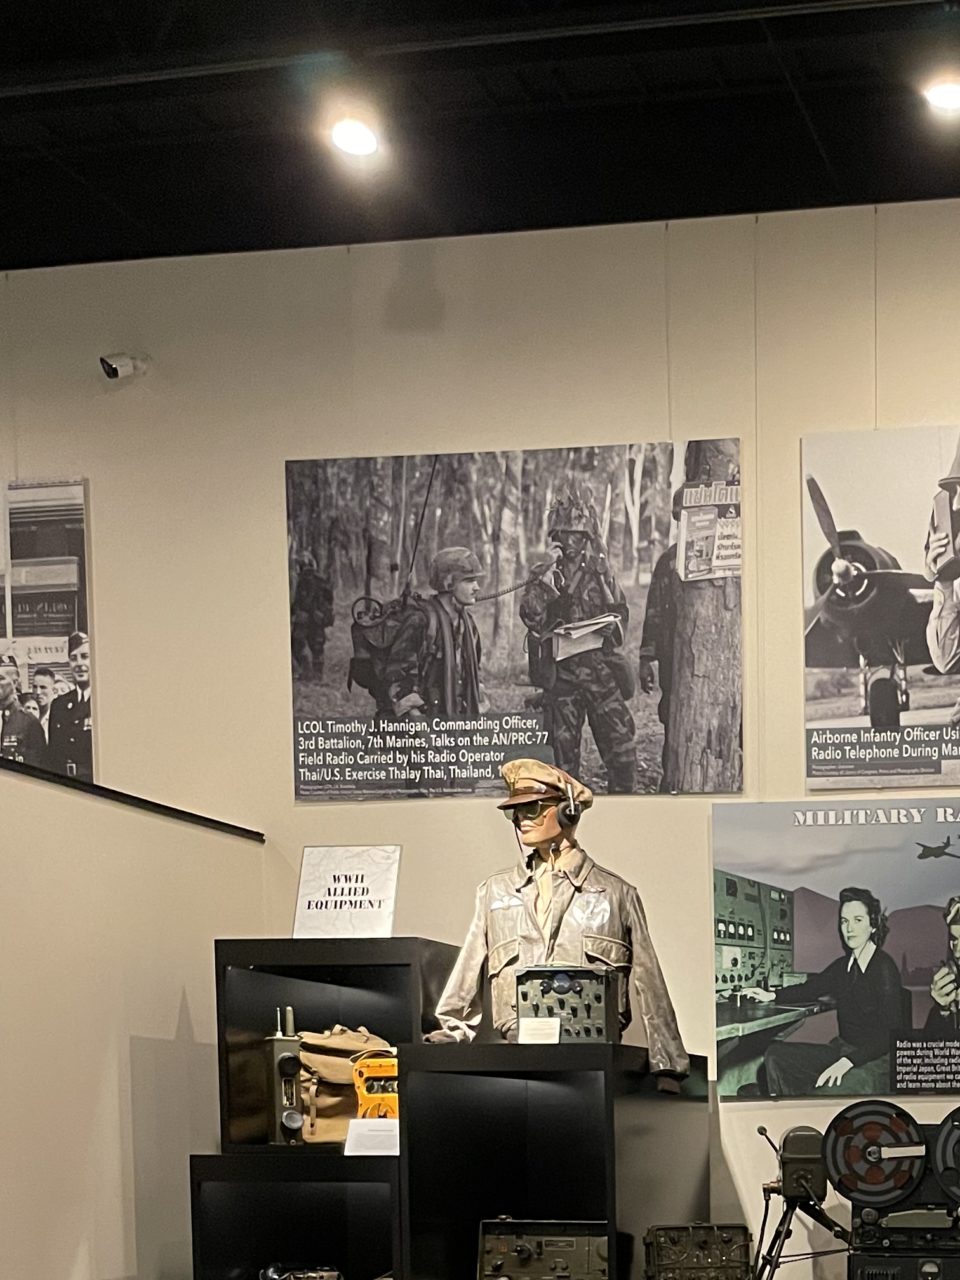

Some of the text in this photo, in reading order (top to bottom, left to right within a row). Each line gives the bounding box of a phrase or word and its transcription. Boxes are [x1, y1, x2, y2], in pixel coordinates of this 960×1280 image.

[299, 714, 538, 737] LCOL Timothy J. Hannigan, Commanding Officer,
[299, 731, 549, 752] 3rd Battalion, 7th Marines, Talks on the AN/PRC-77
[811, 730, 857, 743] Airborne
[861, 728, 901, 746] Infantry
[904, 727, 940, 740] Officer
[299, 749, 506, 767] Field Radio Carried by his Radio Operator
[812, 746, 842, 760] Radio
[844, 744, 900, 762] Telephone
[901, 743, 940, 761] During
[299, 769, 343, 781] Thai/U.S.
[346, 768, 386, 780] Exercise
[389, 767, 420, 783] Thalay
[423, 767, 446, 781] Thai,
[449, 766, 496, 780] Thailand,
[793, 808, 925, 825] MILITARY
[333, 874, 365, 884] WWII
[324, 887, 369, 897] ALLIED
[307, 899, 385, 910] EQUIPMENT
